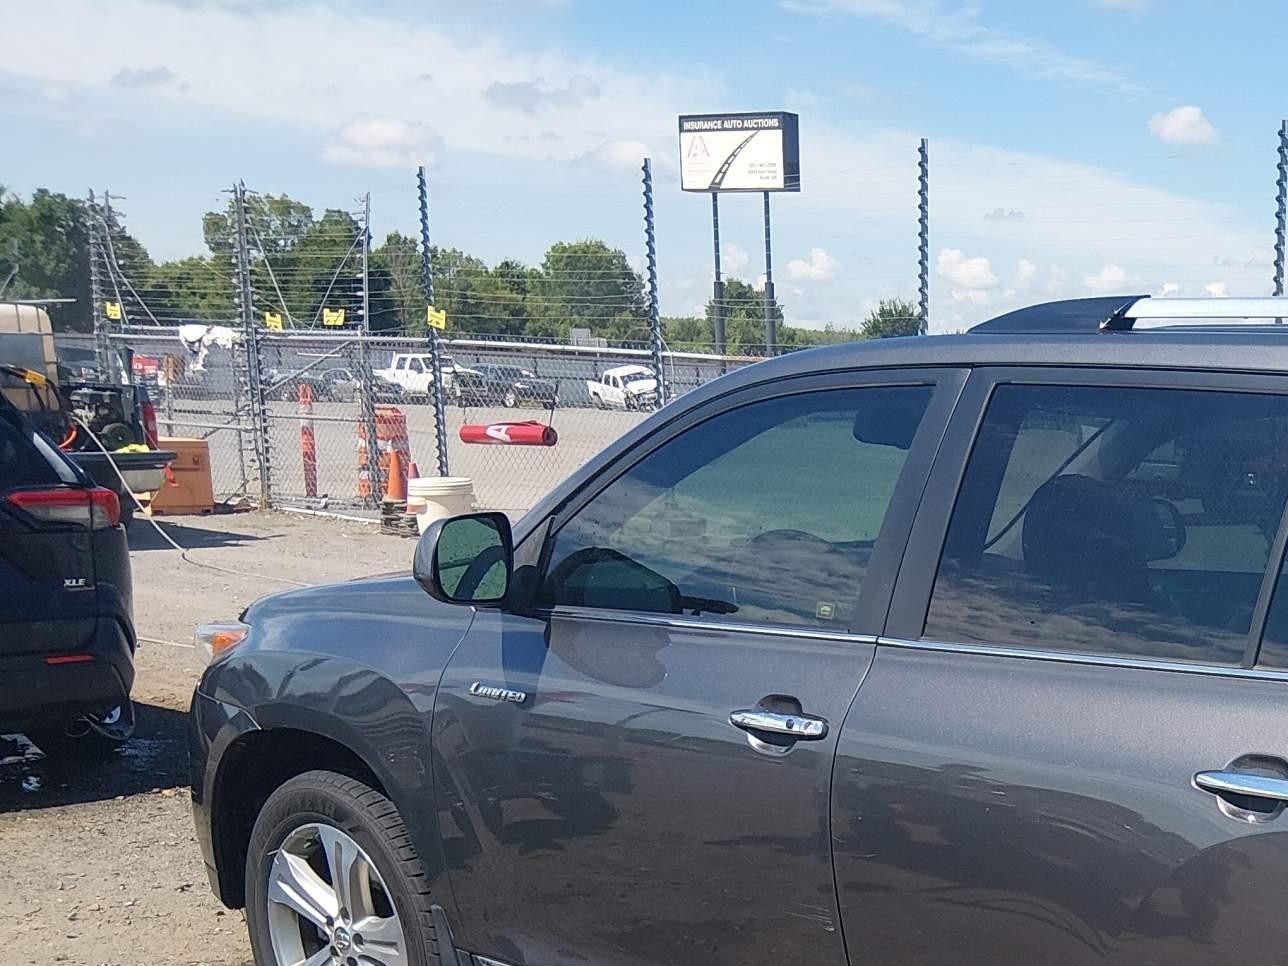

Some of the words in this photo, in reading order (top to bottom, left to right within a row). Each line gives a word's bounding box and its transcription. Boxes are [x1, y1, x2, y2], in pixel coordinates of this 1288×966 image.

[683, 120, 722, 130] INSURANCE
[723, 119, 743, 129] AUTO
[743, 118, 779, 129] AUCTIONS
[63, 578, 87, 587] XLE
